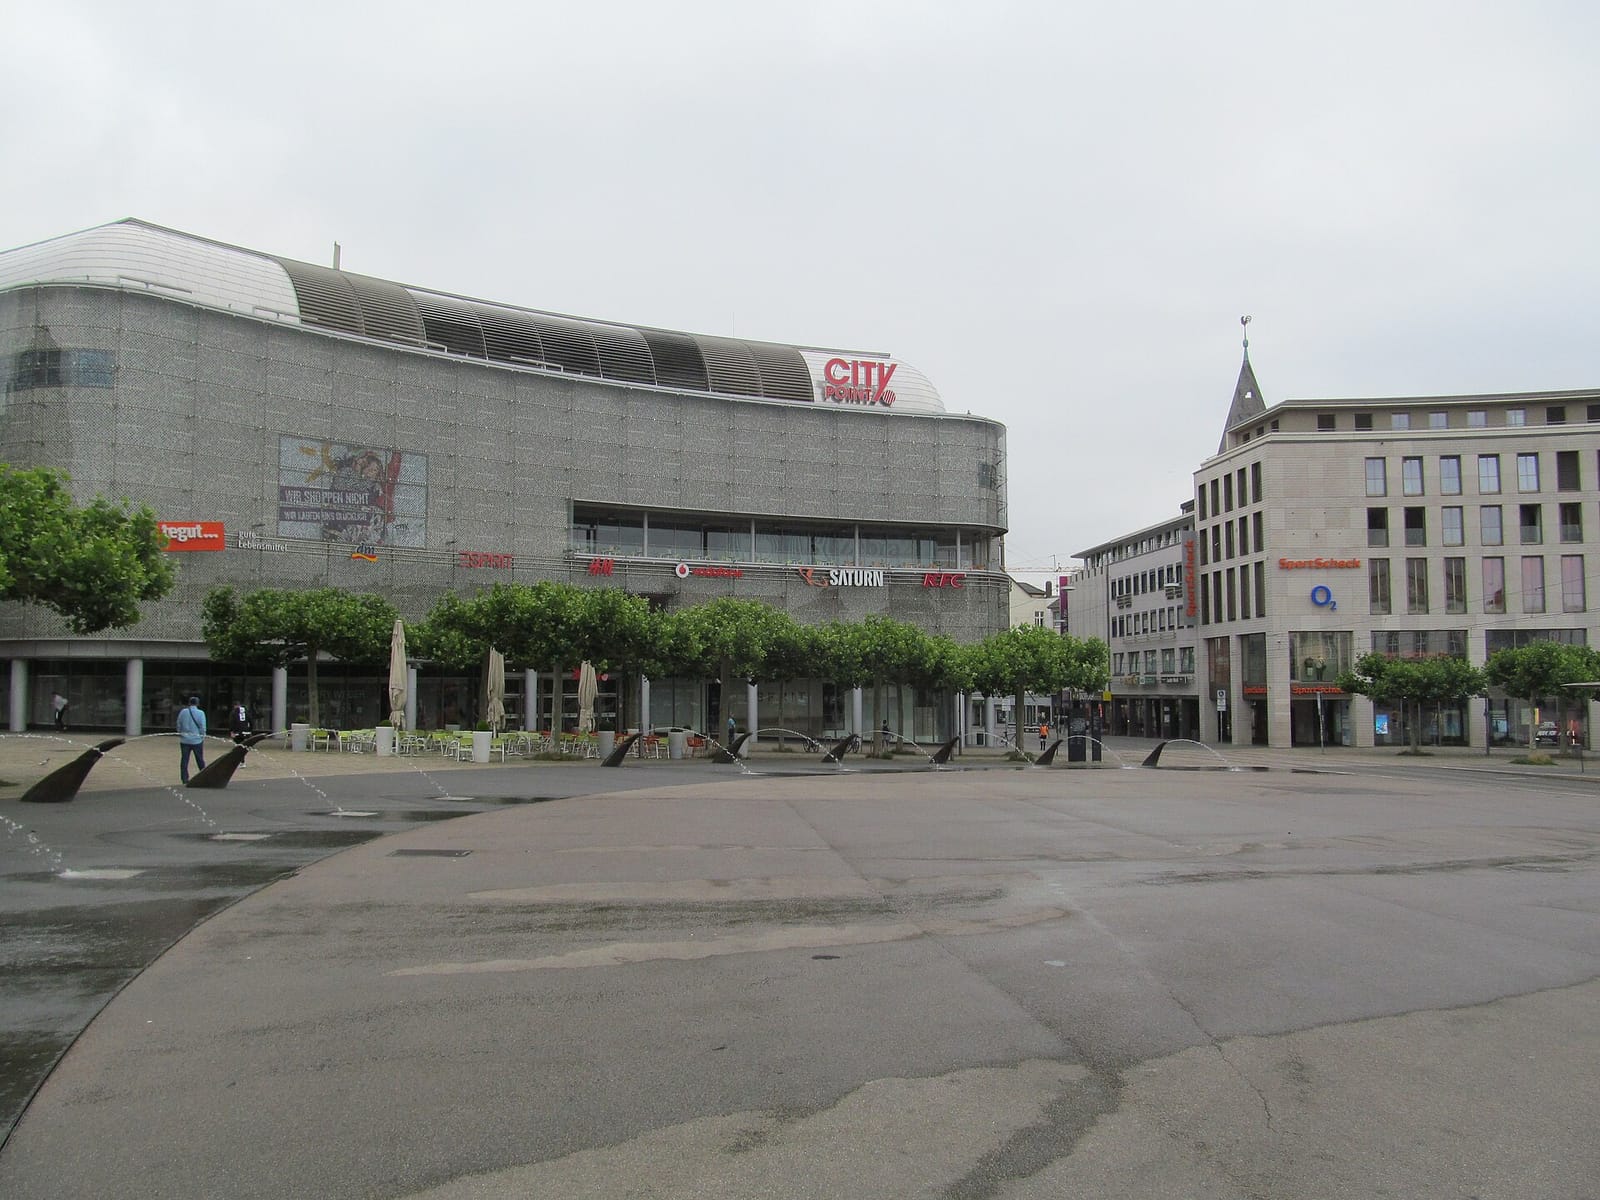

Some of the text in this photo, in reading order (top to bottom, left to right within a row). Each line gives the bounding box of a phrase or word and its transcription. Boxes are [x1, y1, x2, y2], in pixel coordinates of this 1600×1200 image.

[824, 358, 897, 402] CITY
[825, 386, 872, 401] POINT
[285, 490, 302, 503] WIR
[345, 492, 370, 505] NICHT
[238, 540, 288, 552] Lebensmittel
[460, 551, 513, 570] ESPRIT
[1279, 558, 1361, 571] SportScheck
[692, 566, 744, 578] vodafone
[829, 569, 884, 587] SATURN
[1184, 540, 1197, 617] SportScheck
[923, 573, 967, 589] KFC
